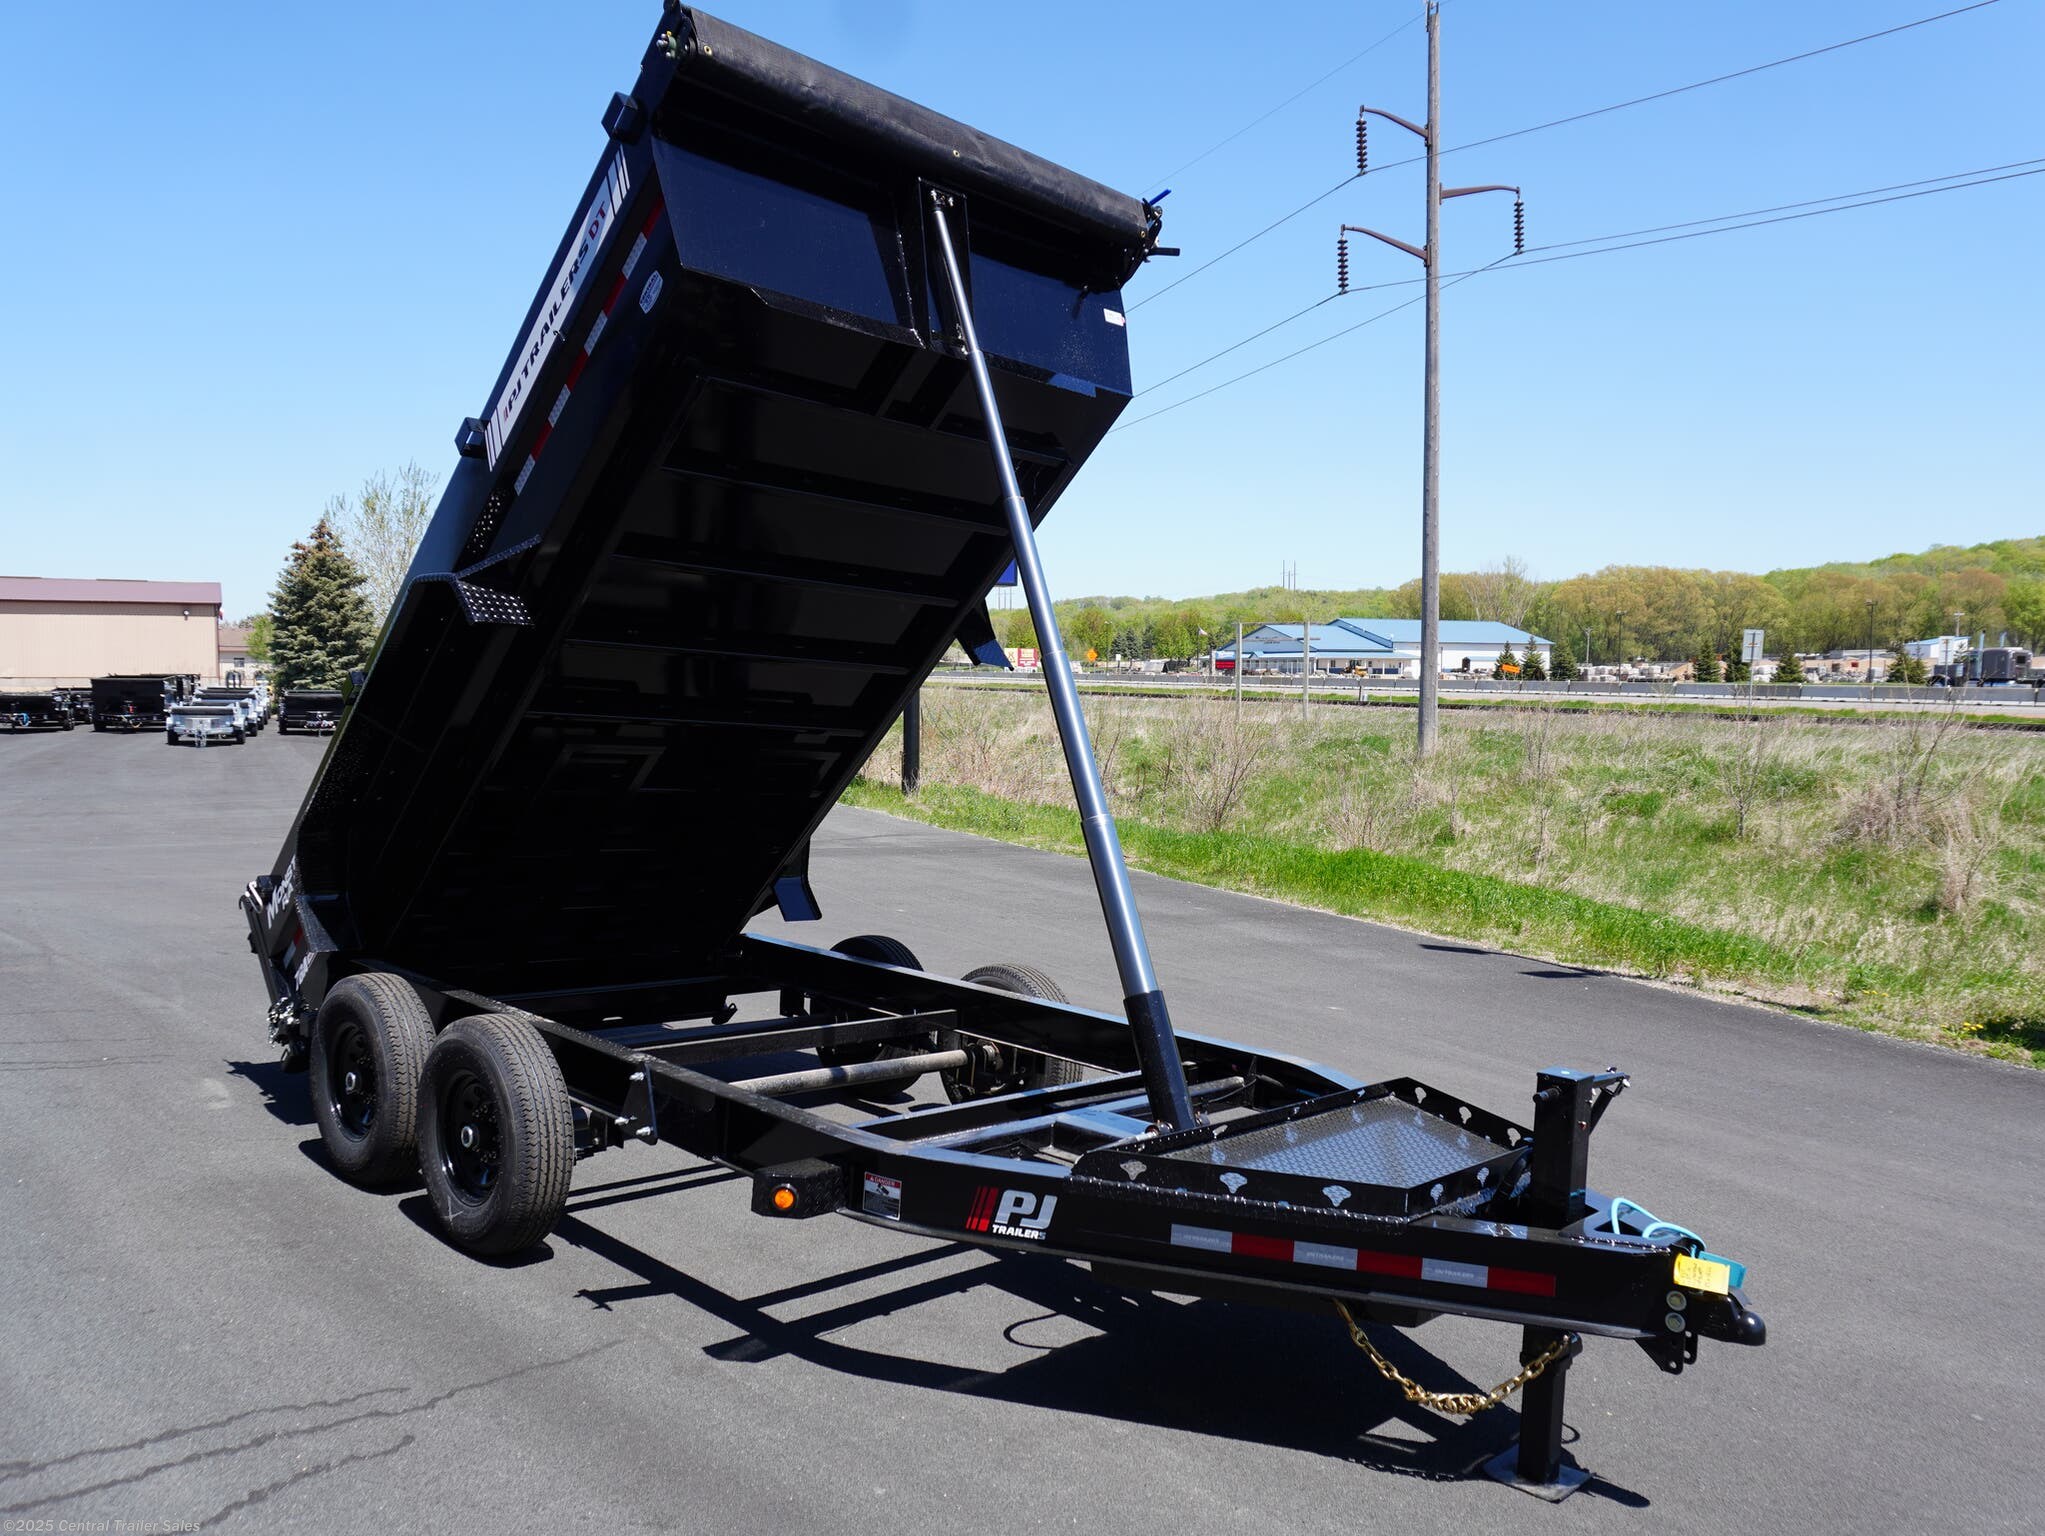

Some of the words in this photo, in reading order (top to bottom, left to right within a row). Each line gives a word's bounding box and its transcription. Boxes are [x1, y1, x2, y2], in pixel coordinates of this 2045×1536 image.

[507, 379, 522, 412] PJ
[521, 239, 589, 380] TRAILERS
[588, 200, 607, 241] DT
[994, 1188, 1058, 1230] PJ
[992, 1223, 1047, 1240] TRAILERS
